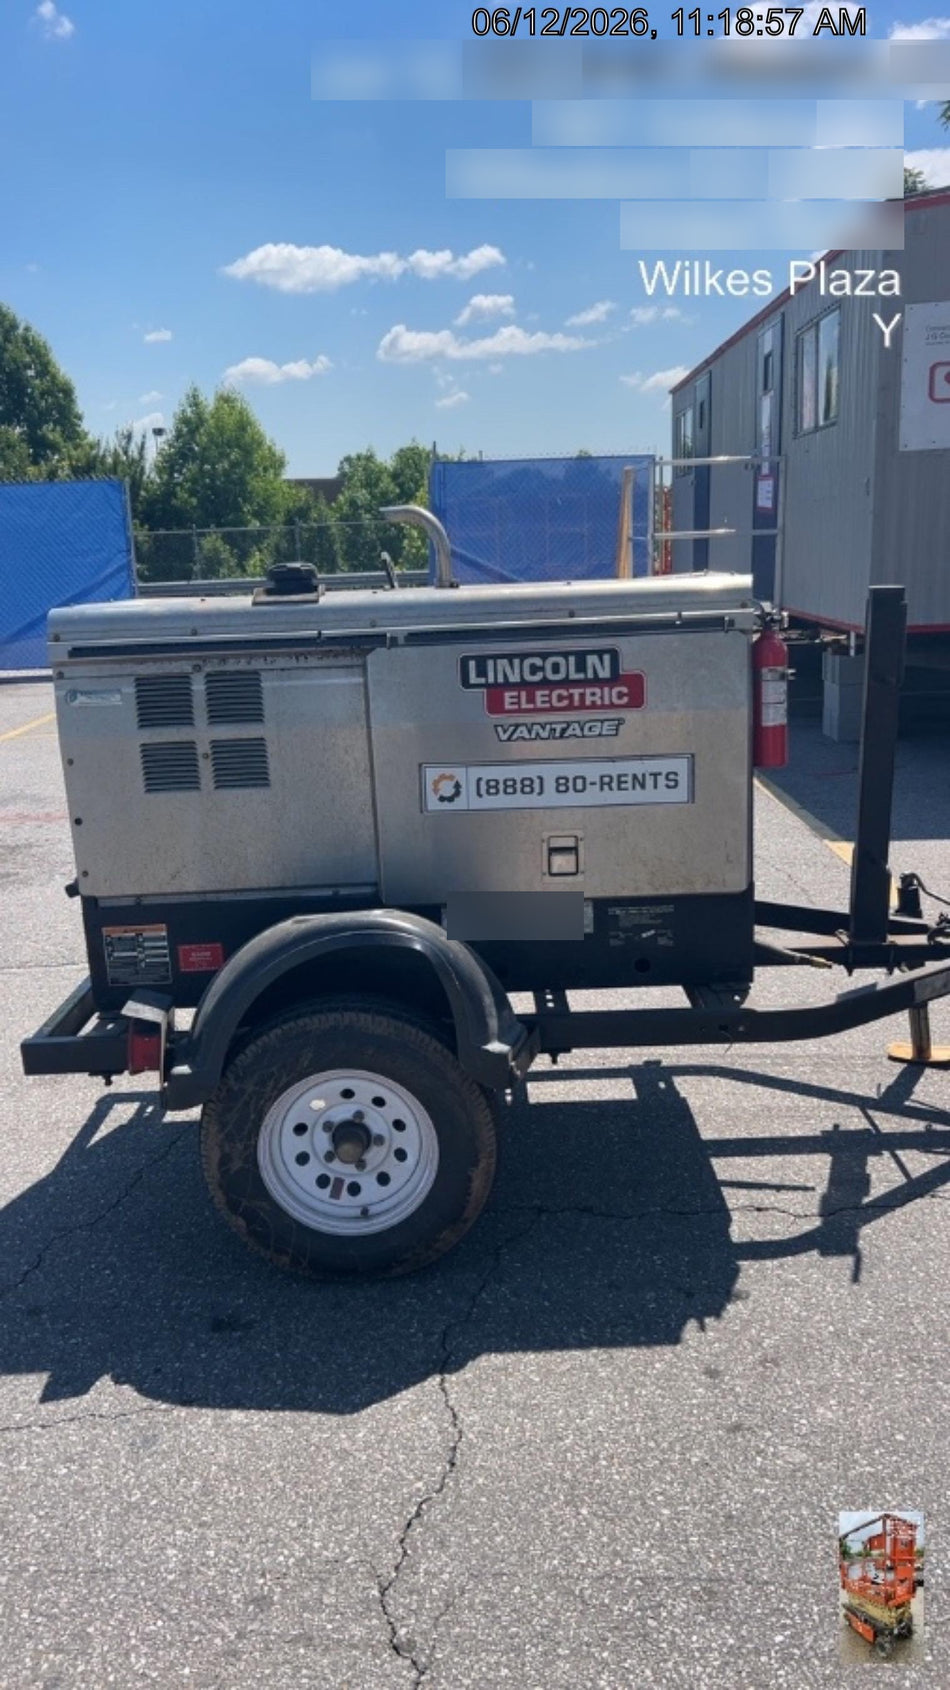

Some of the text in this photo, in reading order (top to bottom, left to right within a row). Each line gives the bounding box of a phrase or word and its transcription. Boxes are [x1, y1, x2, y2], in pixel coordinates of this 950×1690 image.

[468, 653, 612, 685] LINCOLN
[504, 686, 630, 710] ELECTRIC
[495, 719, 621, 742] VANTAGE
[475, 771, 679, 798] (888) 80-RENTS
